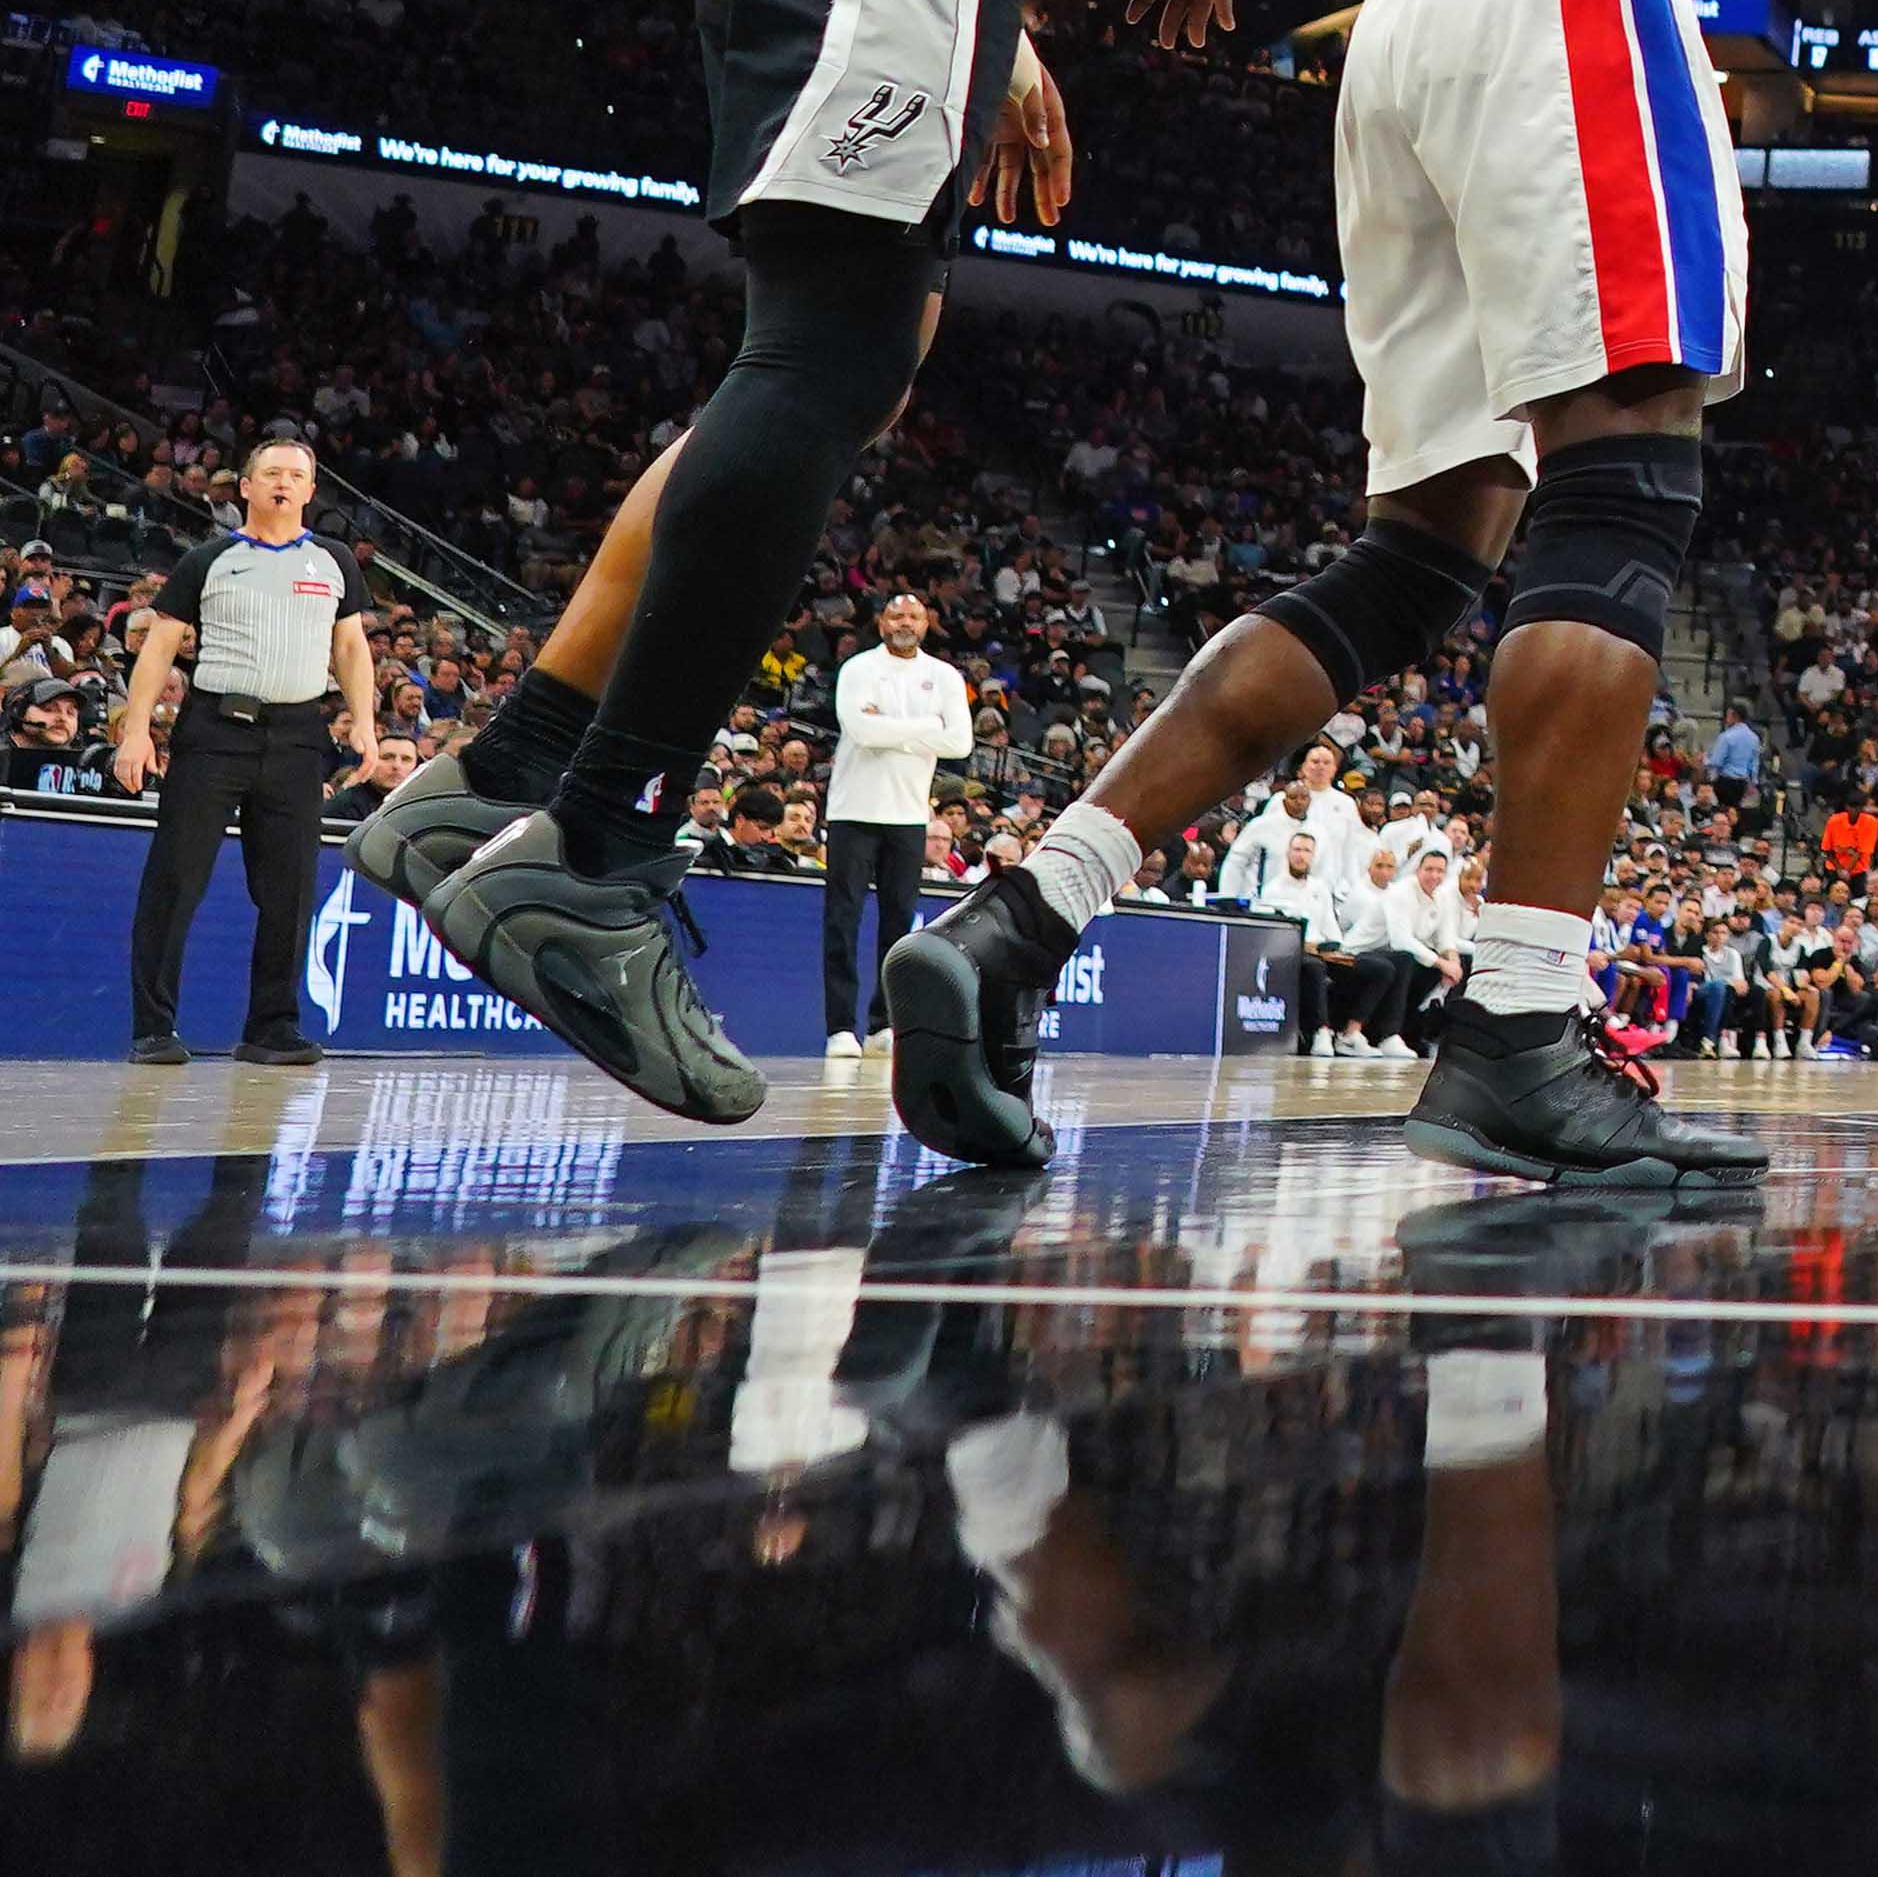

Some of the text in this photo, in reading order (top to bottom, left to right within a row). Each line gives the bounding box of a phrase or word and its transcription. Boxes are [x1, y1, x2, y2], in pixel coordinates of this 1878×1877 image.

[107, 58, 204, 92] Methodist
[377, 136, 438, 165] We're
[439, 145, 485, 173] here
[485, 152, 517, 177] for
[516, 160, 562, 183] your
[561, 168, 639, 200] growing
[639, 174, 701, 208] family.
[1067, 238, 1118, 265] We're
[1118, 247, 1154, 270] here
[1154, 252, 1181, 273] for
[1180, 260, 1217, 279] your
